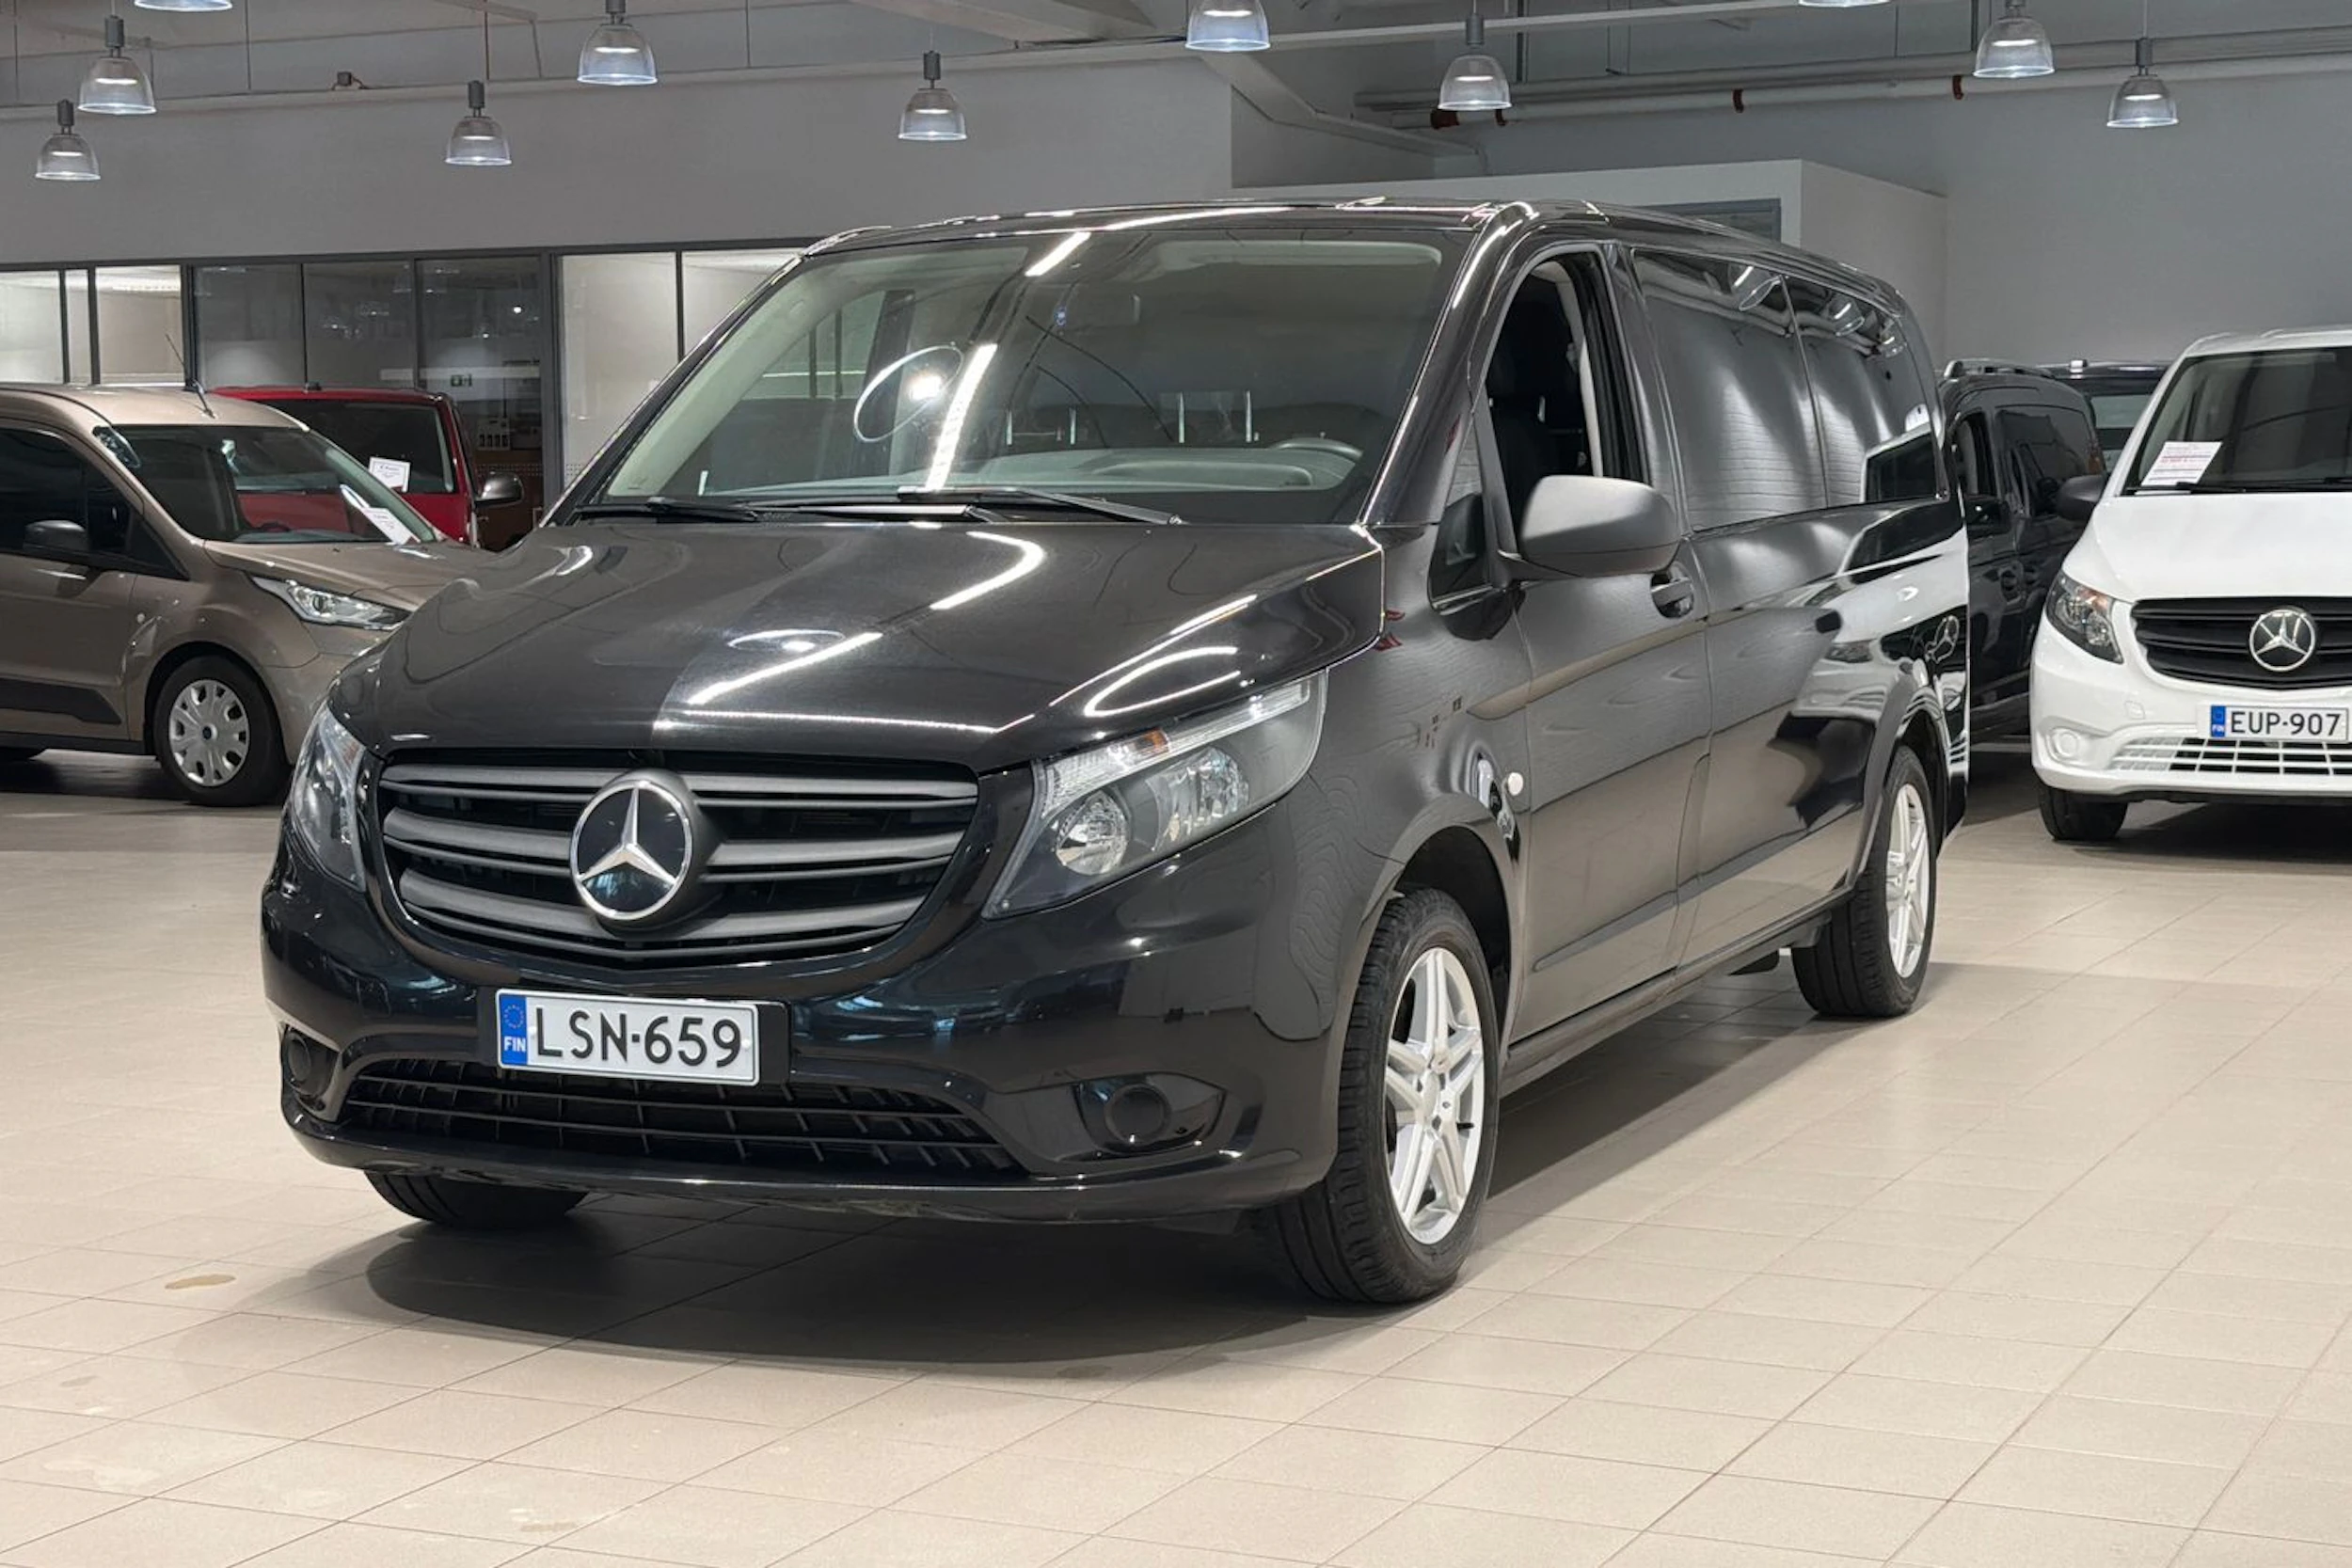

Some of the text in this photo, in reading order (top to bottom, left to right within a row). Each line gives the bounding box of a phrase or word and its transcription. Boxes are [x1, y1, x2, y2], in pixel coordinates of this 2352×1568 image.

[2231, 711, 2341, 736] EUP-907
[503, 1036, 527, 1053] FIN
[535, 1007, 741, 1069] LSN-659
